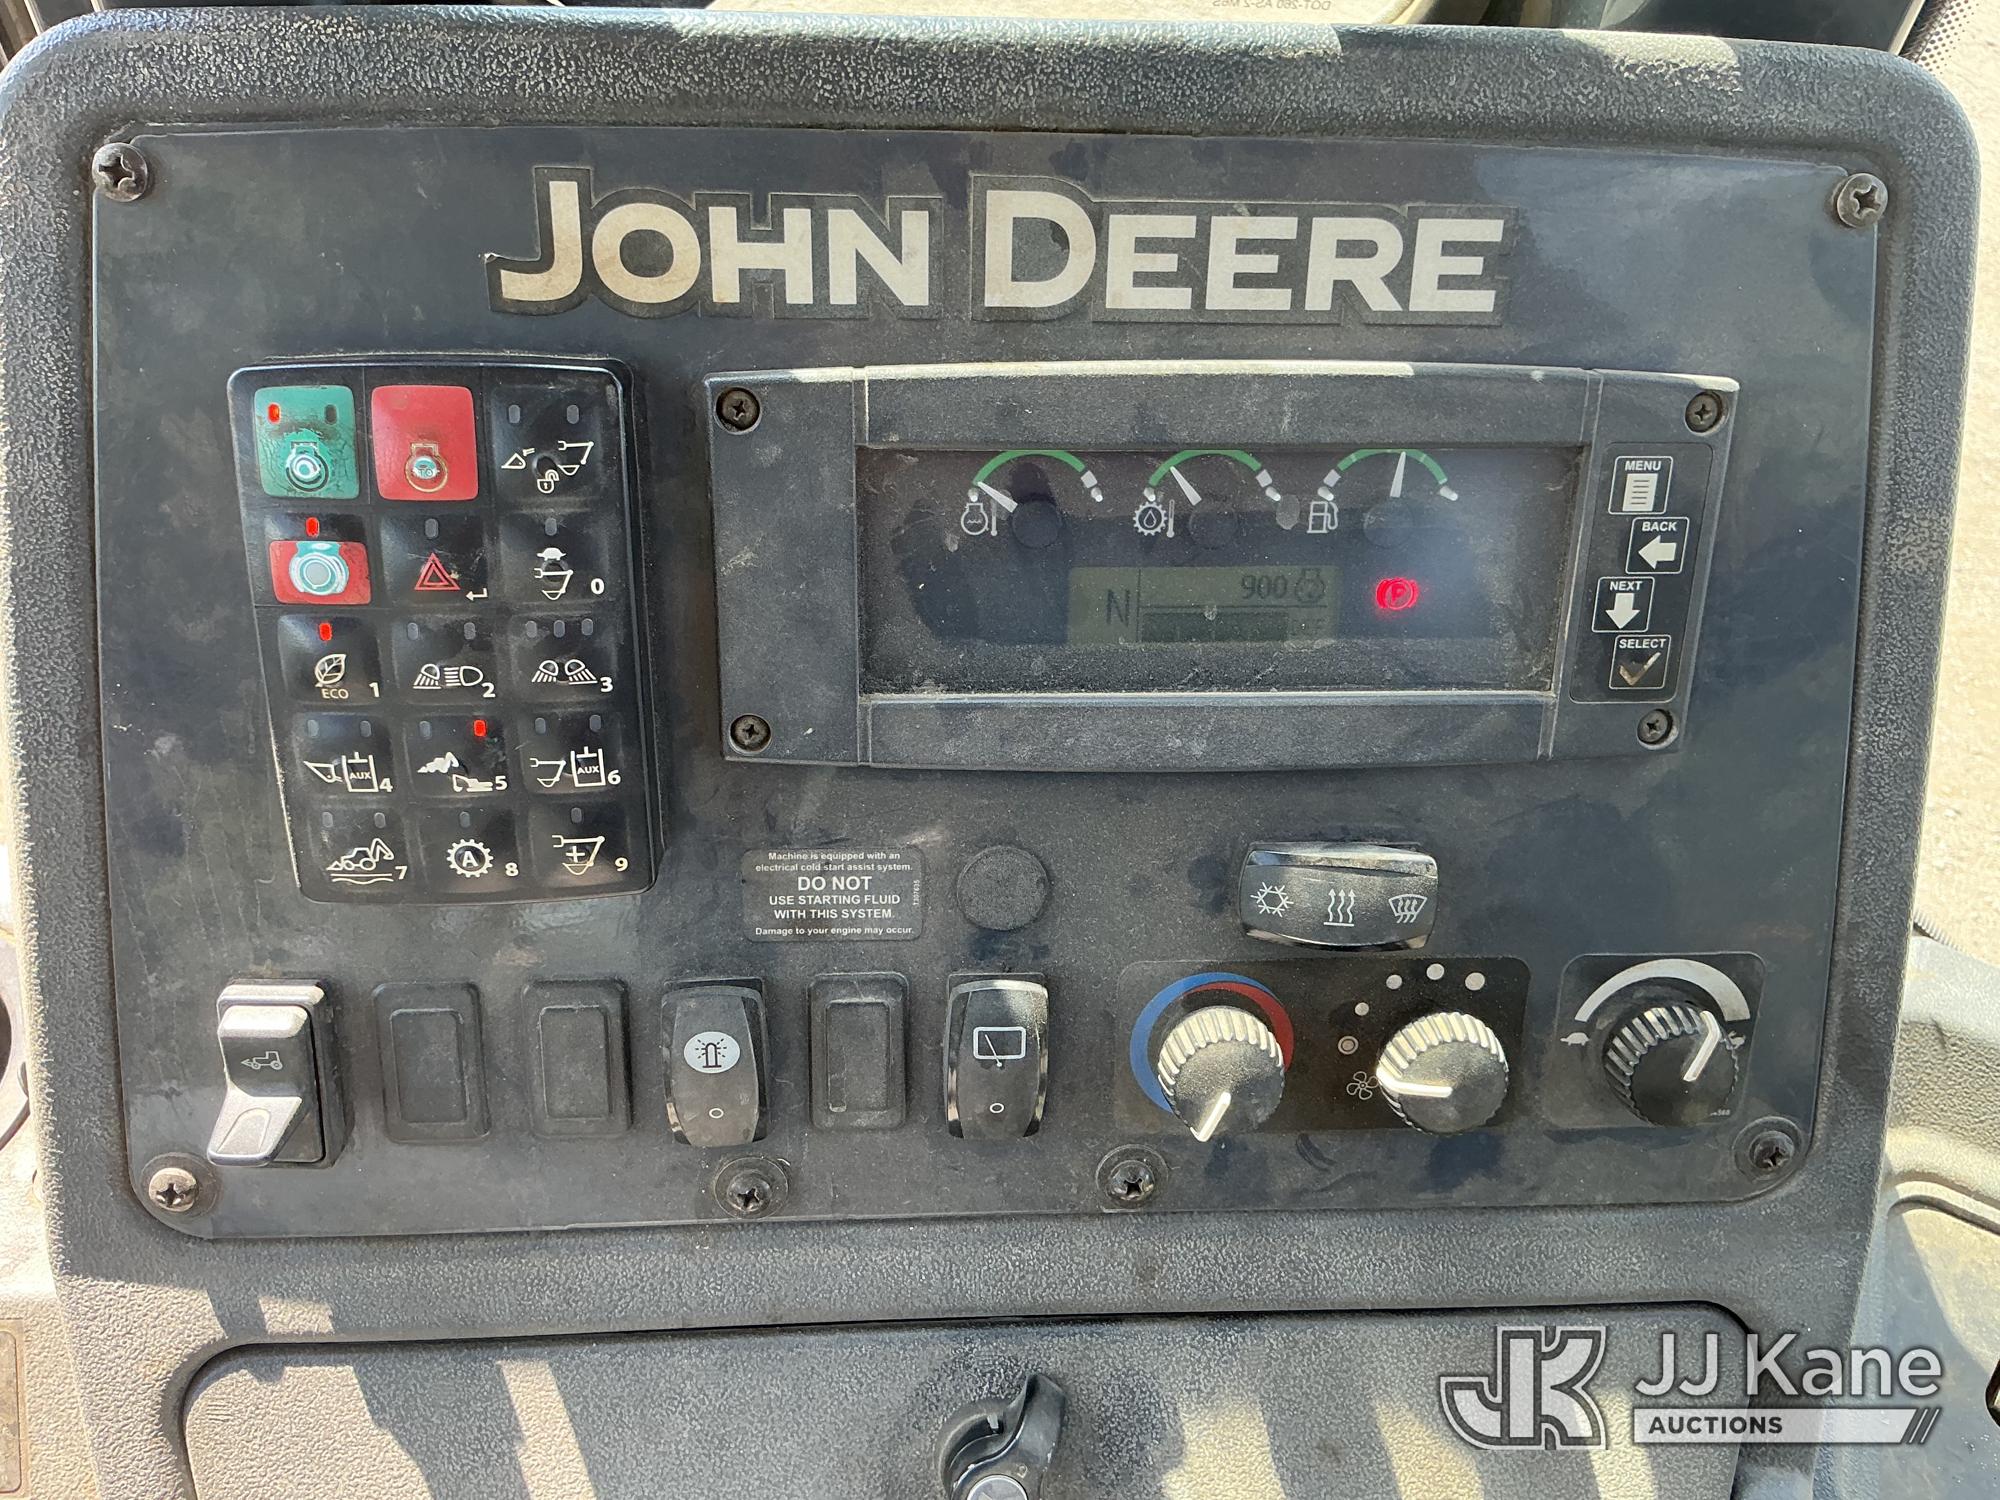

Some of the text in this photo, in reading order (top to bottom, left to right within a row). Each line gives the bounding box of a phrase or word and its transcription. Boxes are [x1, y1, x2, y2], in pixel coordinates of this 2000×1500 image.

[500, 181, 1505, 312] JOHN DEERE
[1625, 461, 1662, 471] MENU
[1642, 521, 1678, 531] BACK
[590, 578, 605, 595] 0
[1609, 581, 1642, 591] NEXT
[1106, 574, 1288, 626] N 900
[1619, 639, 1667, 648] SELECT
[370, 683, 380, 697] 1
[482, 683, 495, 697] 2
[600, 677, 613, 692] 3
[321, 687, 349, 699] ECO
[350, 770, 371, 780] AUX
[577, 764, 600, 775] AUX
[379, 777, 393, 792] 4
[495, 776, 508, 790] 5
[607, 770, 621, 785] 6
[462, 850, 478, 867] A
[768, 852, 808, 860] Machine
[810, 852, 818, 860] is
[821, 852, 865, 862] equipped
[867, 852, 886, 860] with
[505, 862, 519, 877] 8
[616, 857, 628, 872] 9
[755, 863, 913, 872] electrical cold start assist system.
[395, 866, 408, 880] 7
[798, 876, 872, 891] DO NOT
[769, 895, 900, 905] USE STARTING FLUID
[774, 909, 894, 919] WITH THIS SYSTEM.
[755, 927, 793, 937] Damage
[795, 927, 805, 935] to
[808, 929, 828, 937] your
[831, 927, 862, 936] engine
[864, 928, 884, 936] may
